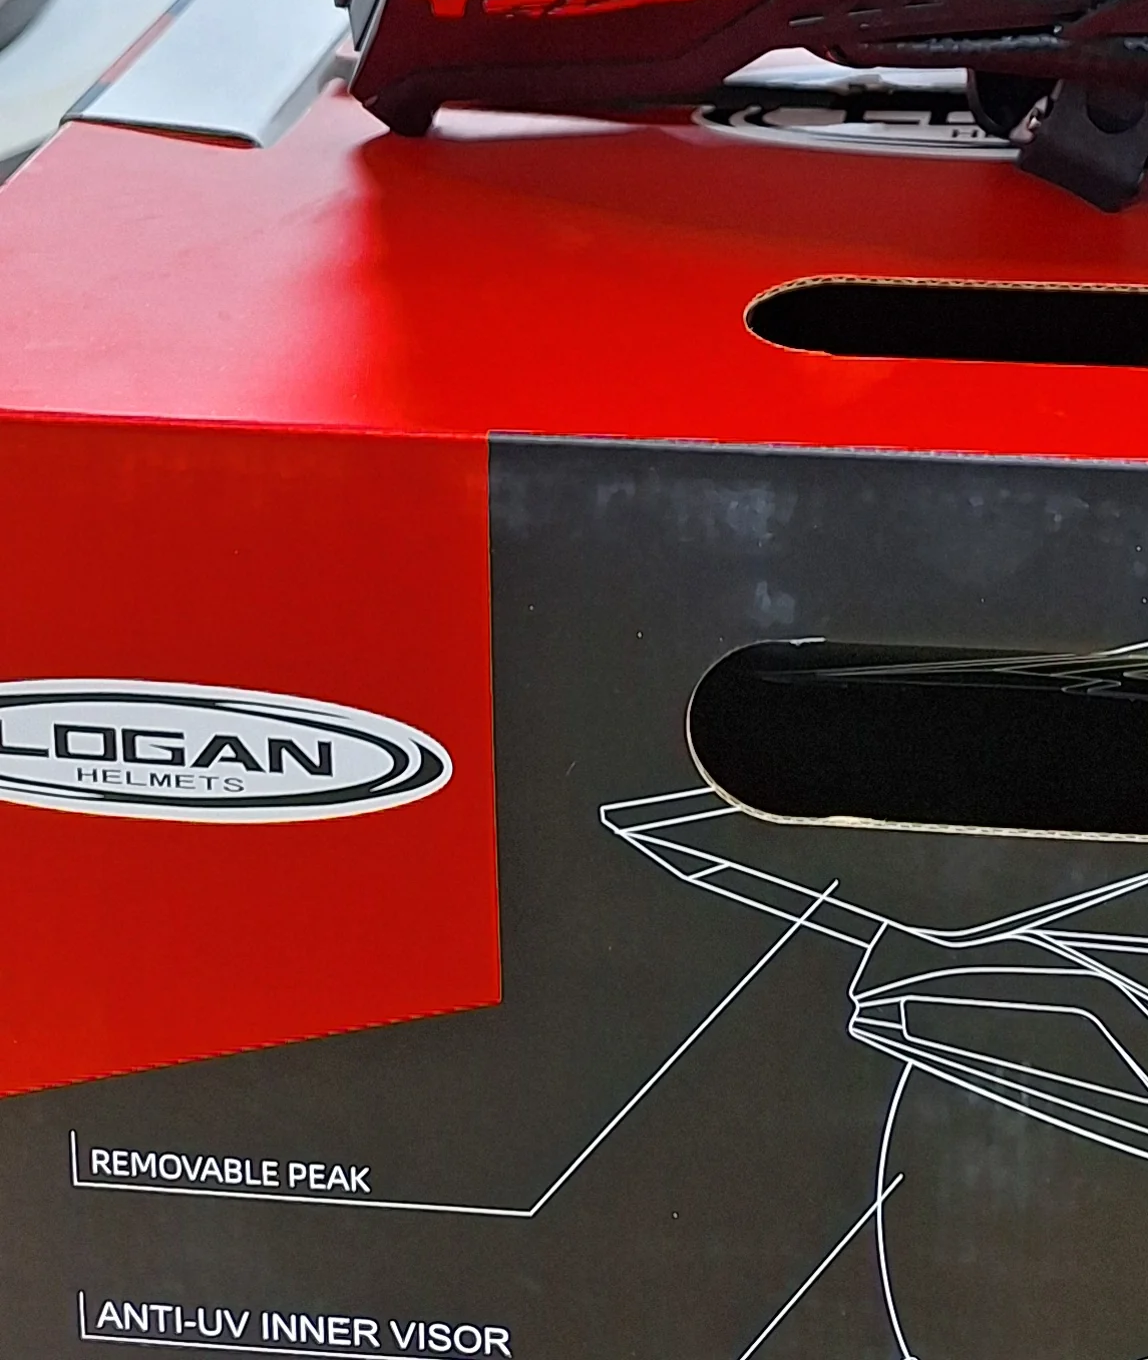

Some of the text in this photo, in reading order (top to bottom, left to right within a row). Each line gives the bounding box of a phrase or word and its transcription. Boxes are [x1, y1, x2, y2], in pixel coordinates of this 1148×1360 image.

[77, 766, 245, 793] HELMETS
[91, 1148, 371, 1194] REMOVABLE PEAK
[97, 1300, 512, 1359] ANTI-UV INNER VISOR
